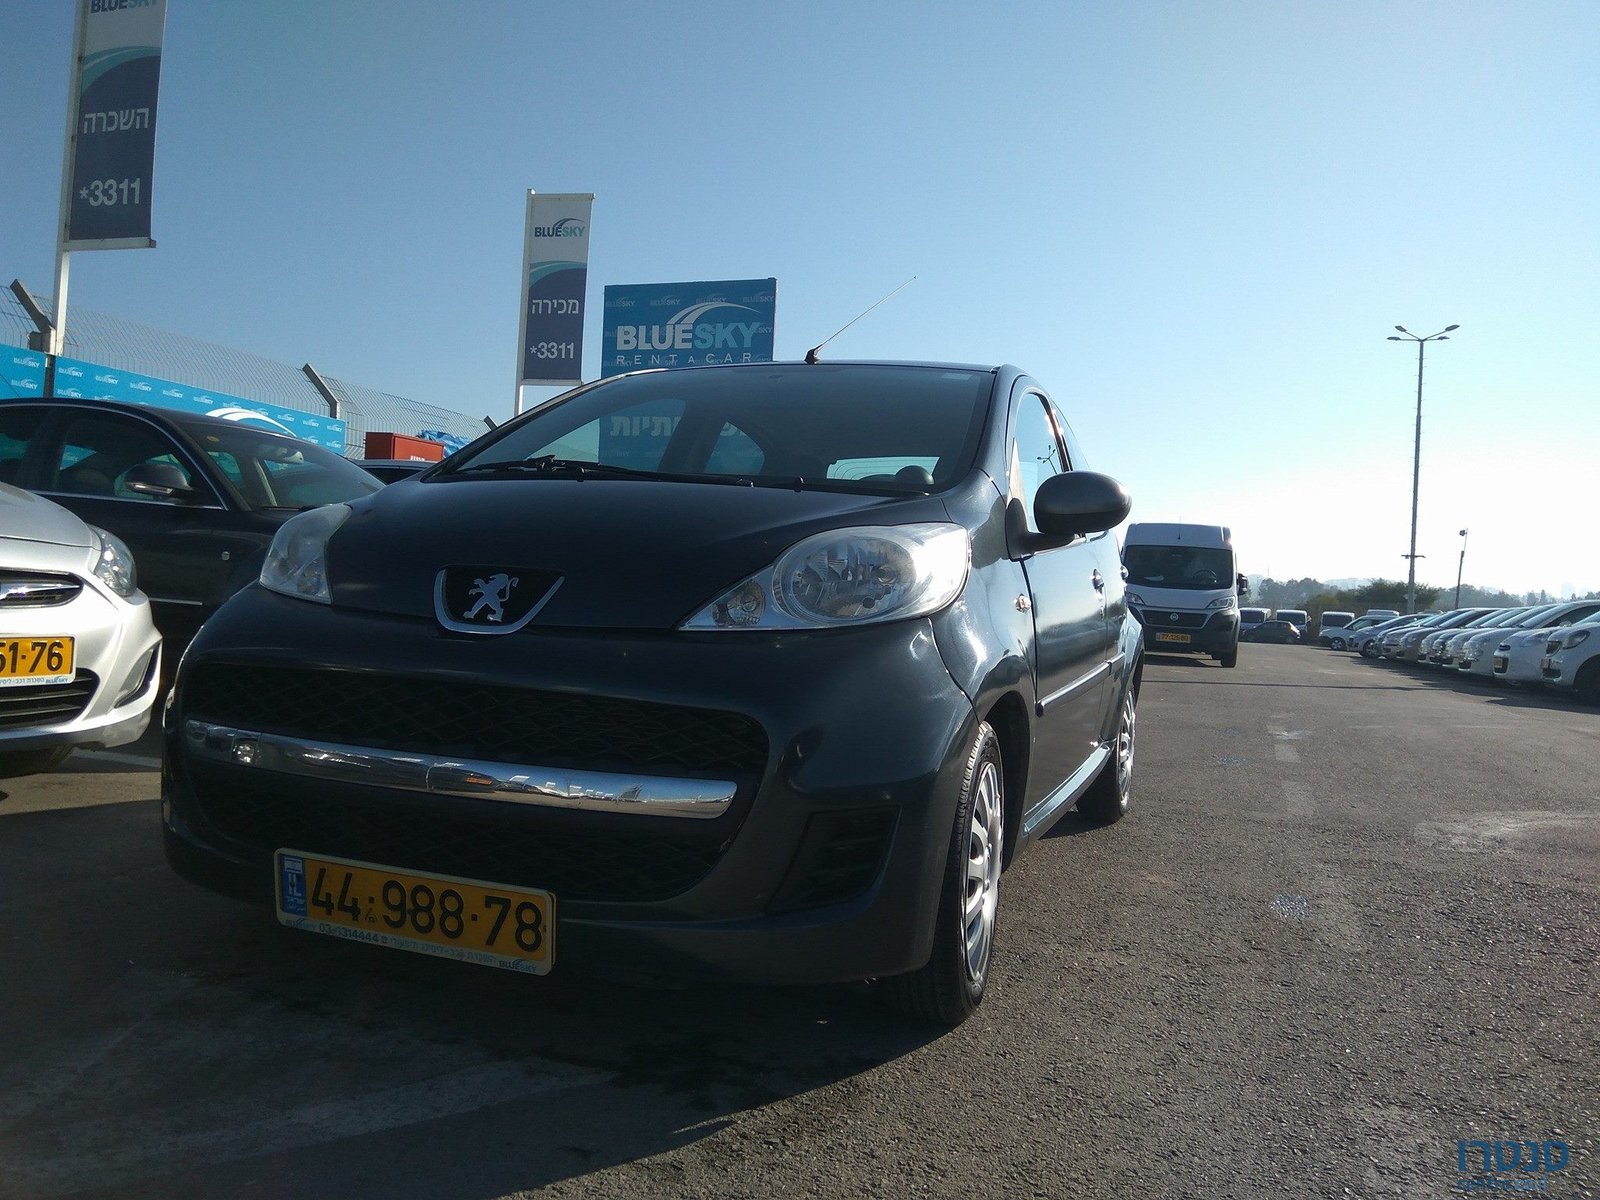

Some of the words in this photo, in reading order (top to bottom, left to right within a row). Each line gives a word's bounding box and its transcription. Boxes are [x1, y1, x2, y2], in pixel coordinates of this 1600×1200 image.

[83, 107, 149, 135] השכרה
[534, 226, 586, 237] BLUESKY
[531, 299, 579, 314] מכירה
[616, 322, 761, 350] BLUESKY
[616, 353, 678, 365] RENT
[705, 352, 752, 363] CAR
